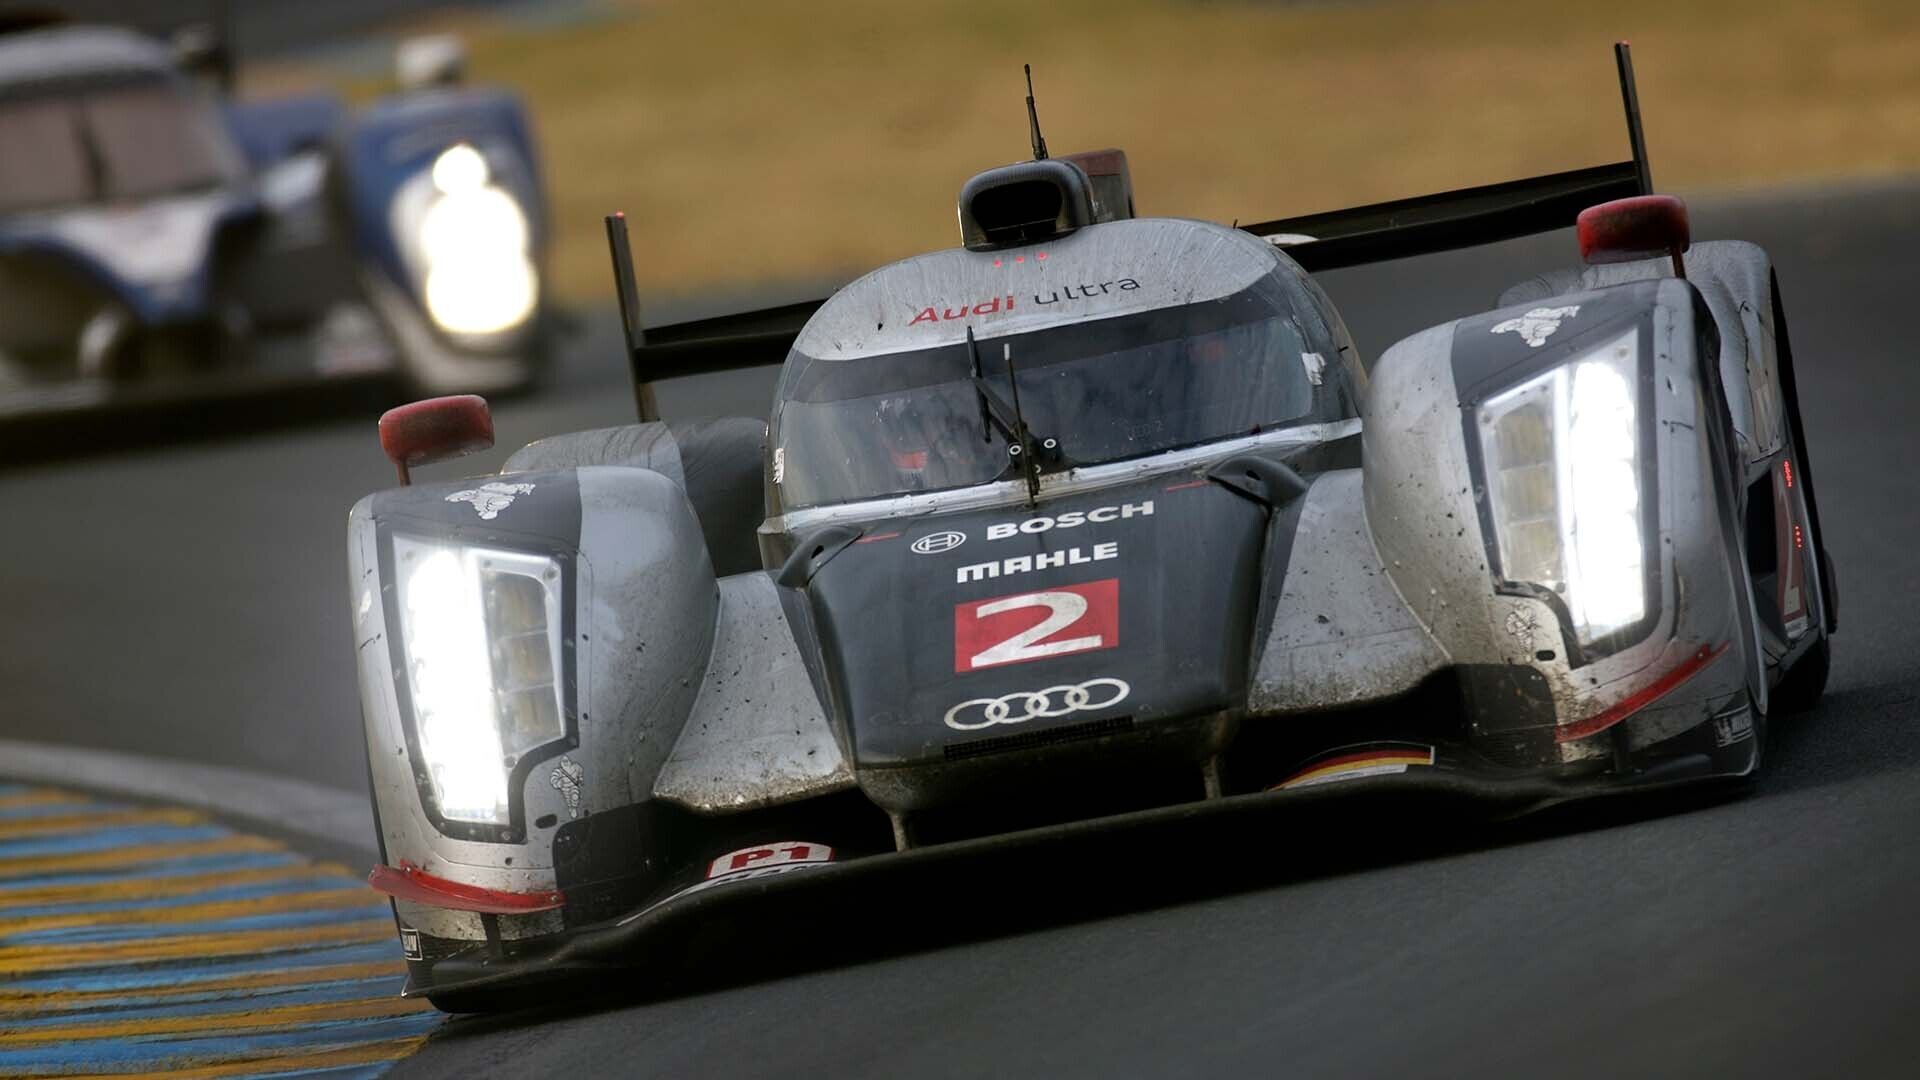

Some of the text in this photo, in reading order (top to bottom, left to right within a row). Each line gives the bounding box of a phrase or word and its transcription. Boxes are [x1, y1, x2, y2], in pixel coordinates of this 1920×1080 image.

[908, 278, 1141, 326] Audi ultra
[987, 500, 1155, 541] BOSCH
[956, 541, 1119, 584] MAHLE
[971, 591, 1103, 668] 2
[730, 846, 811, 870] P1
